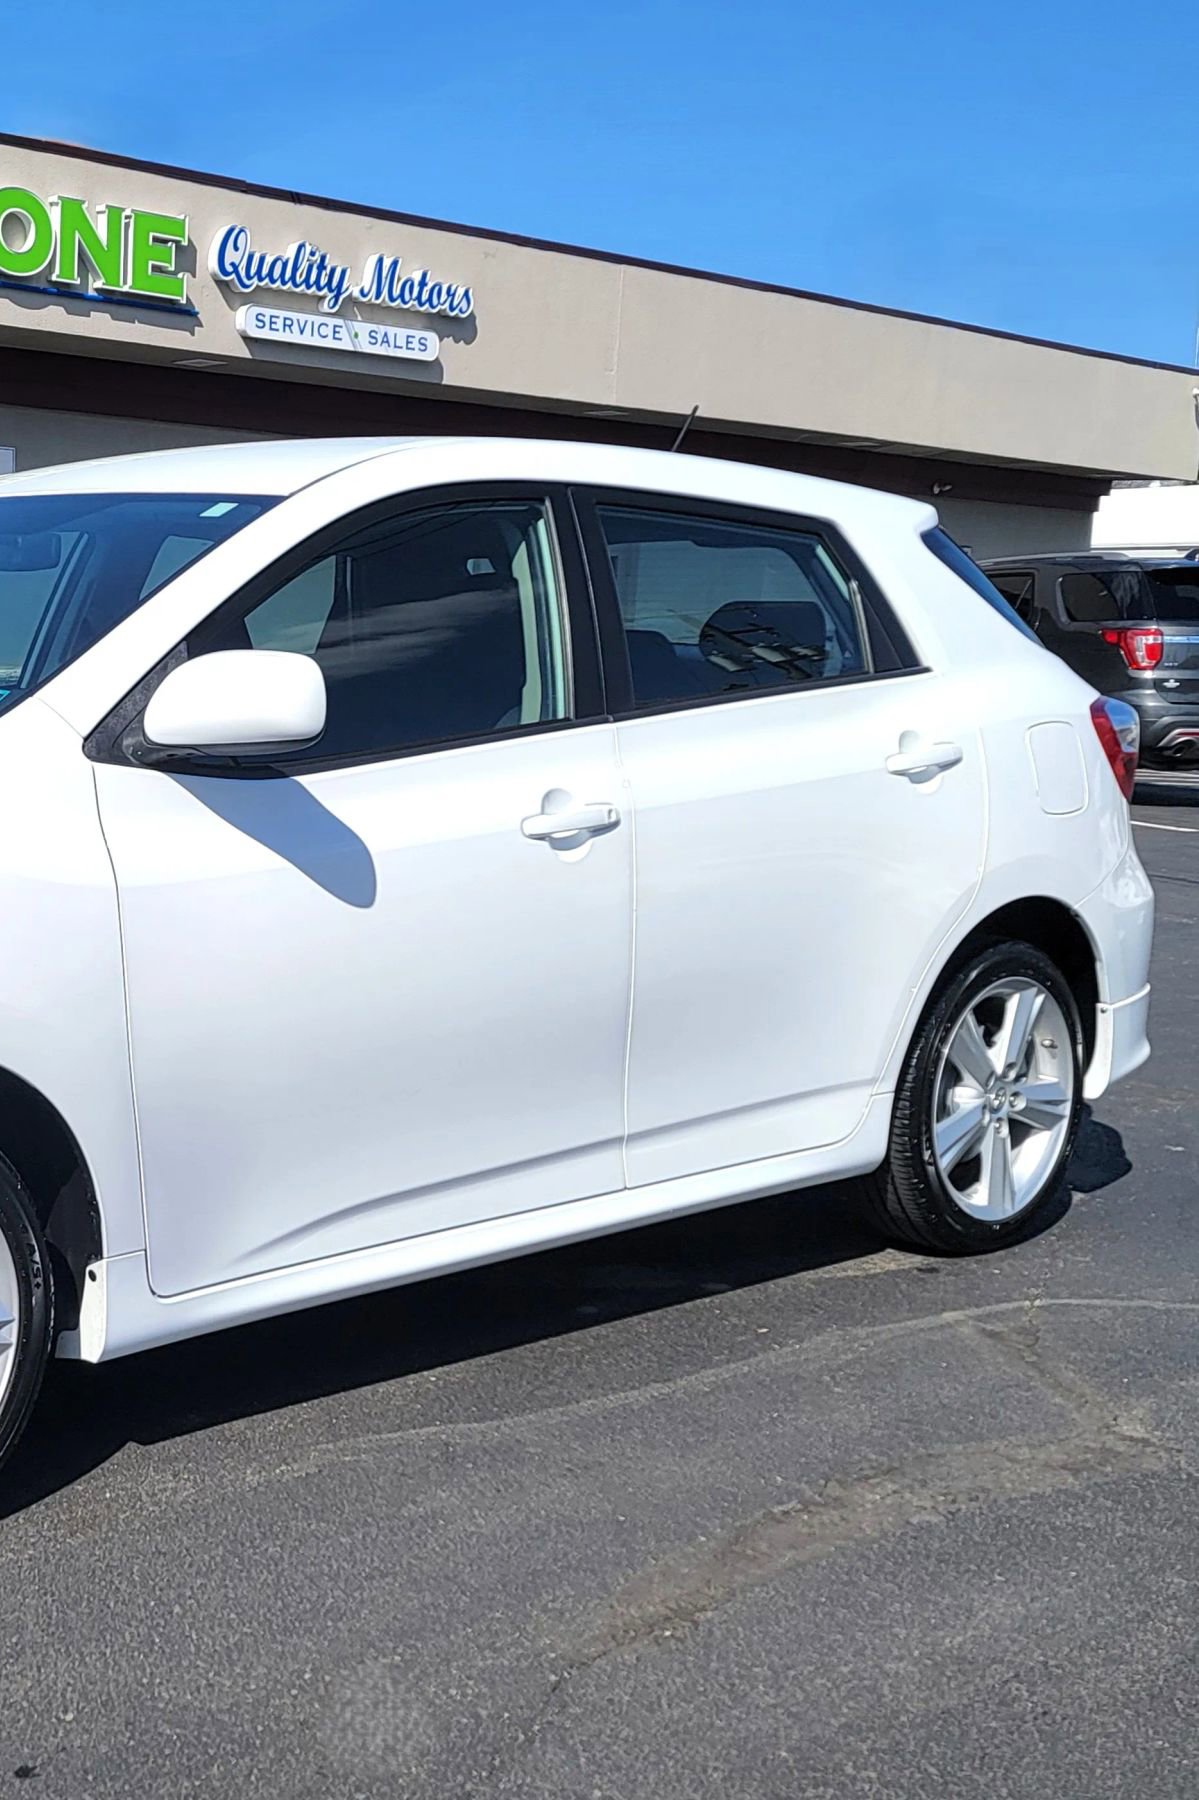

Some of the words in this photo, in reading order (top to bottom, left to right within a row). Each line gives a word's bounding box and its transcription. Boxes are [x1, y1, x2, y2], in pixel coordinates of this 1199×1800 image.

[209, 224, 351, 311] Quality
[355, 252, 474, 318] Motors
[254, 312, 343, 341] SERVICE
[368, 329, 429, 353] SALES
